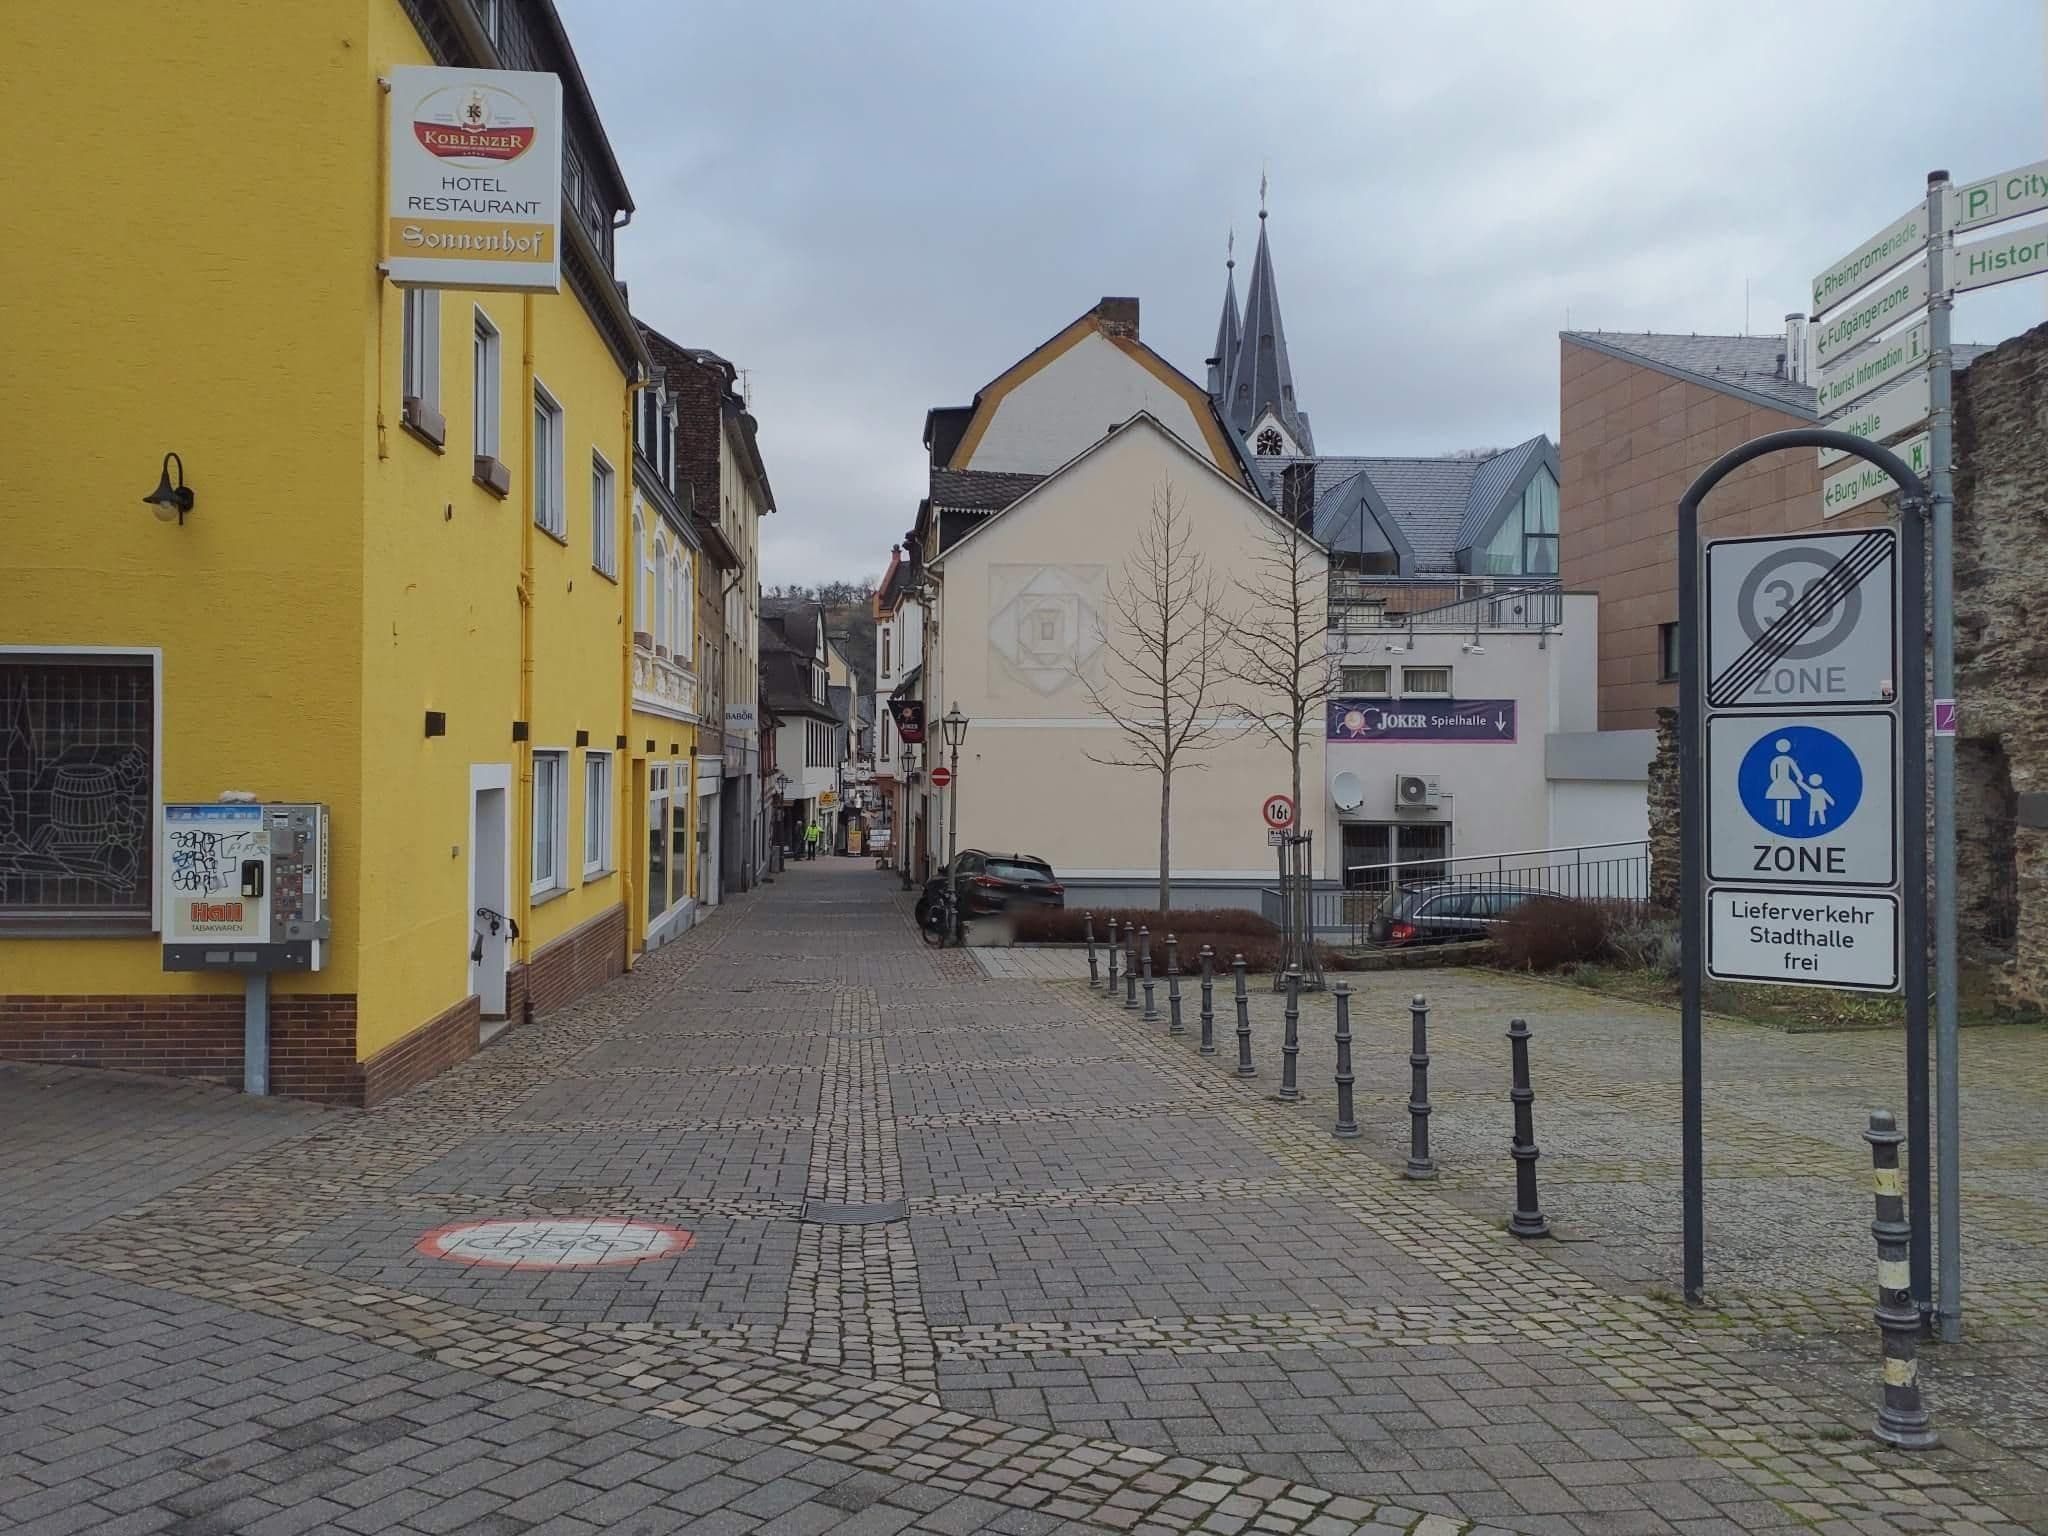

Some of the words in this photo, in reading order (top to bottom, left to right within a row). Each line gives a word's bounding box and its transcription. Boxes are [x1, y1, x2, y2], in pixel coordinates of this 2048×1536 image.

[424, 130, 523, 149] KOBLENZER
[442, 176, 507, 192] HOTEL
[2006, 173, 2048, 201] City
[408, 196, 541, 215] RESTAURANT
[402, 224, 544, 257] Sonnenhof
[1823, 222, 1917, 294] Rheinpromenade
[1968, 240, 2048, 276] Histor
[1828, 285, 1909, 347] Fußgängerzone
[1829, 373, 1855, 400] Tourist
[1857, 347, 1903, 385] Information
[1834, 468, 1889, 503] Burg/Muse
[1753, 667, 1846, 695] ZONE
[1377, 712, 1427, 730] JOKER
[1431, 715, 1487, 728] Spielhalle
[1753, 845, 1846, 874] ZONE
[1731, 901, 1874, 925] Lieferverkehr
[1750, 926, 1854, 948] Stadthalle
[1784, 952, 1818, 971] frei
